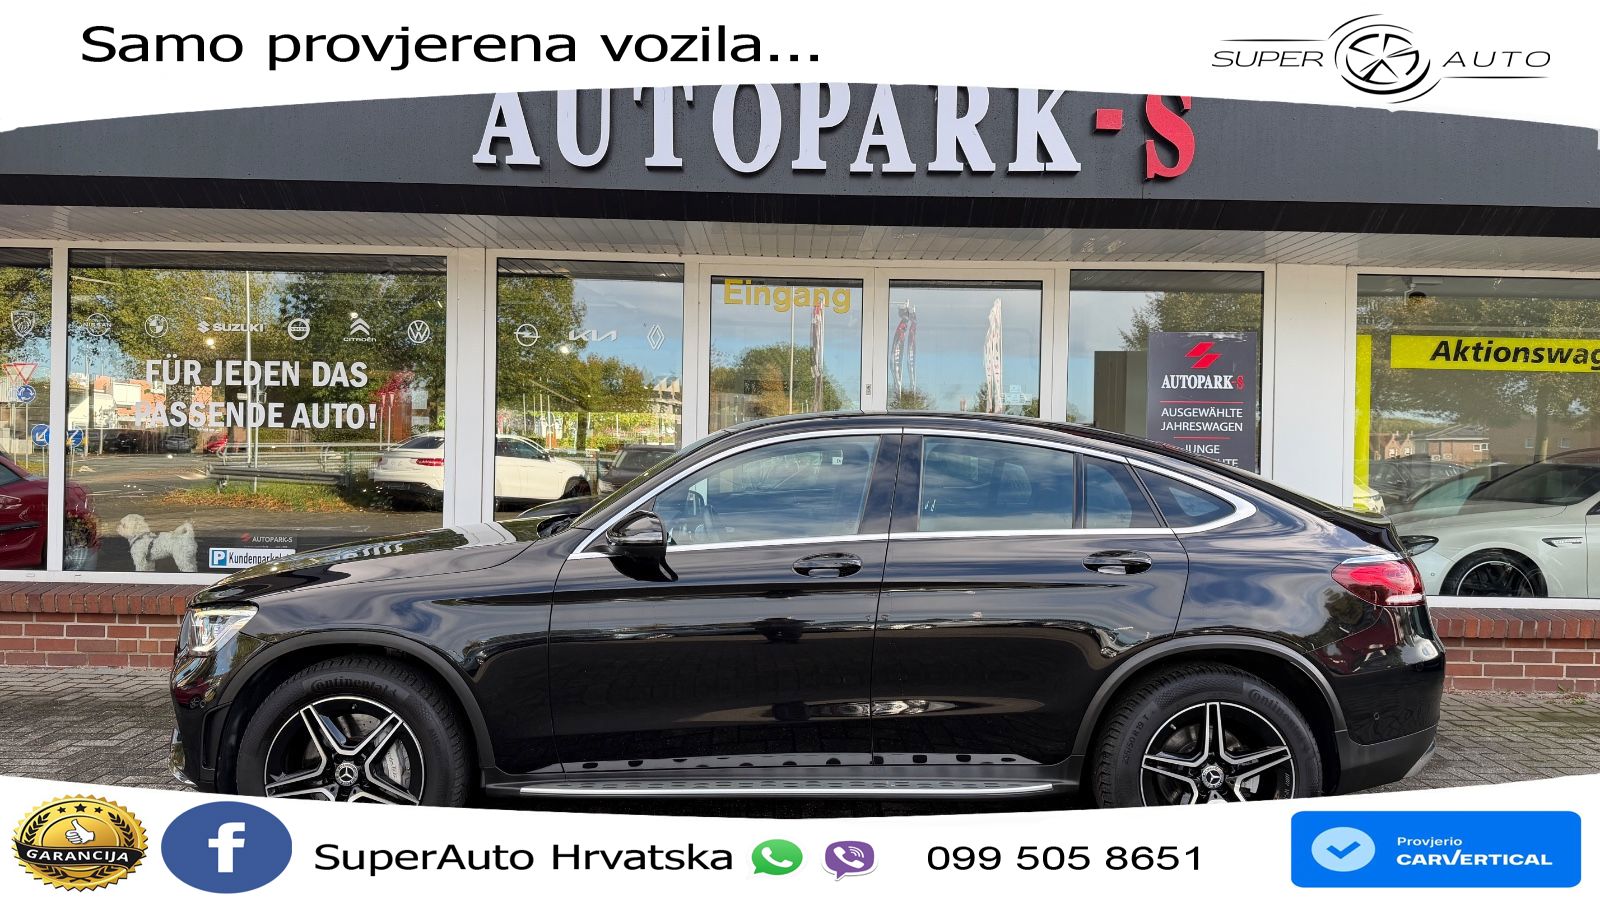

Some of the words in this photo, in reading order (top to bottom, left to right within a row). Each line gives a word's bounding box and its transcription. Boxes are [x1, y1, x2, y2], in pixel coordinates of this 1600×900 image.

[724, 278, 851, 314] Eingang
[212, 322, 265, 332] SUZUKI
[146, 354, 201, 386] FÜR
[211, 360, 300, 387] JEDEN
[312, 361, 368, 388] DAS
[1161, 375, 1245, 390] AUTOPARK-S
[135, 401, 285, 428] PASSENDE
[291, 402, 377, 430] AUTO!
[1161, 407, 1243, 418] AUSGEWÄHLTE
[1161, 421, 1243, 432] JAHRESWAGEN
